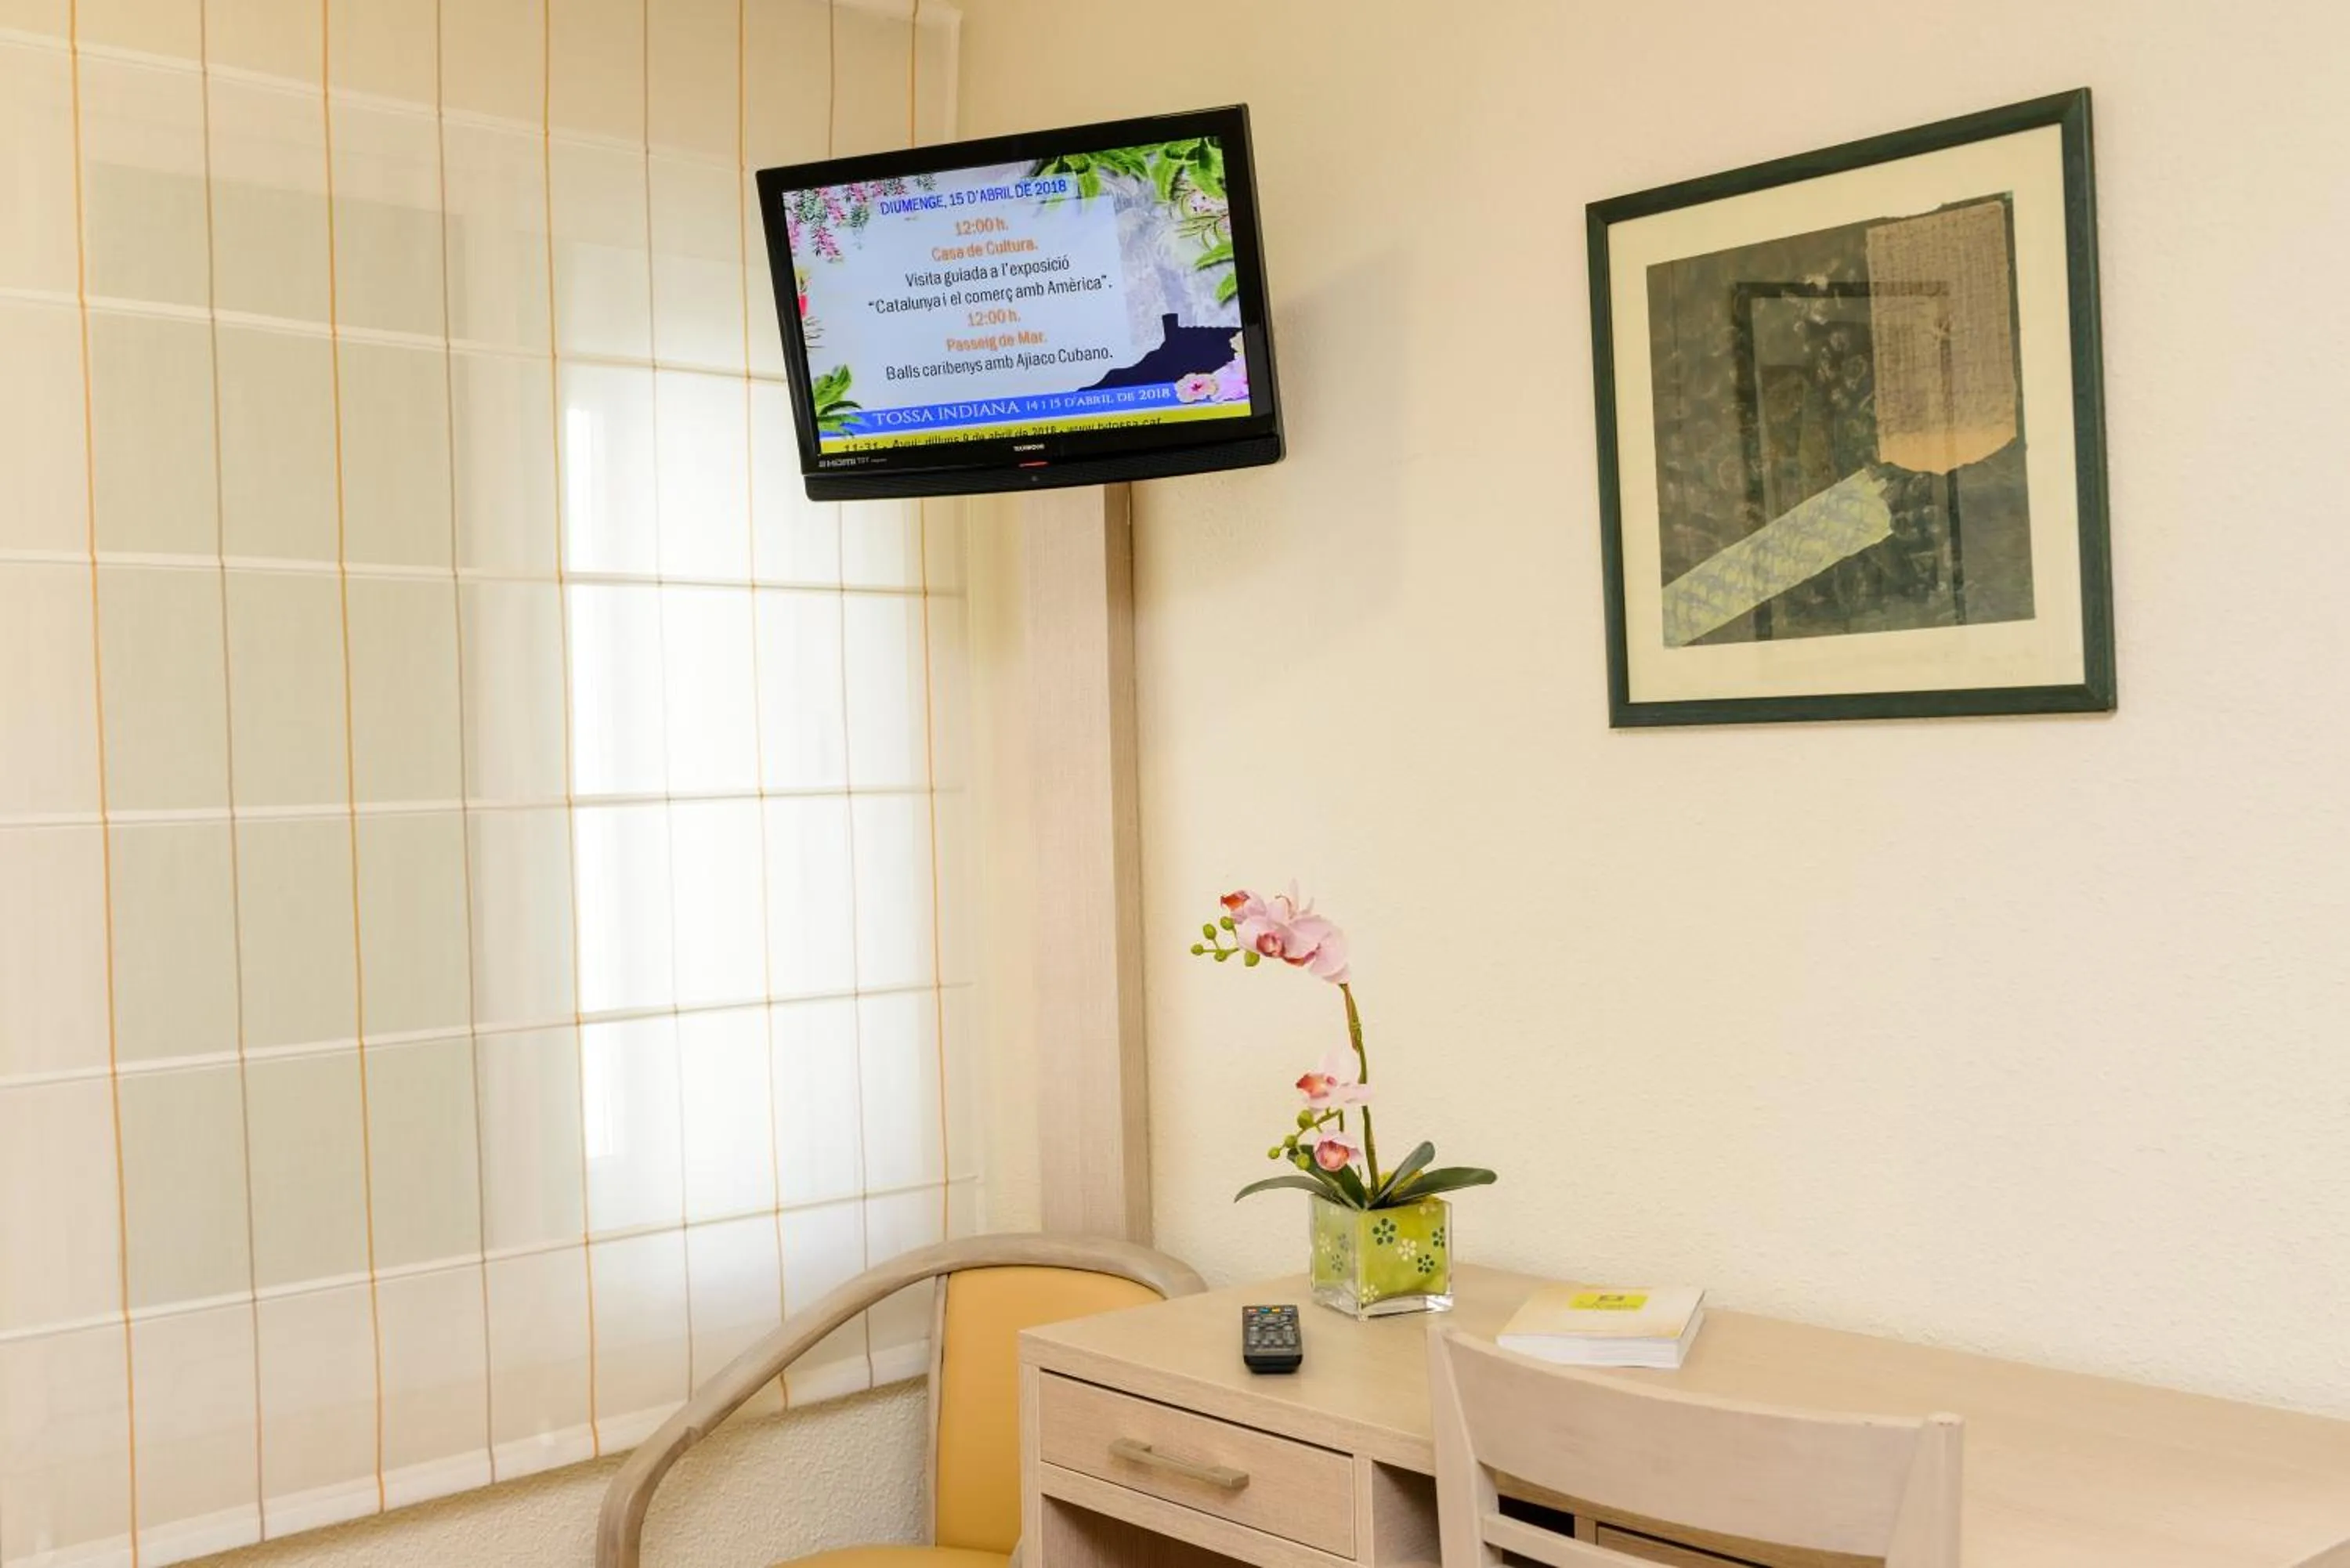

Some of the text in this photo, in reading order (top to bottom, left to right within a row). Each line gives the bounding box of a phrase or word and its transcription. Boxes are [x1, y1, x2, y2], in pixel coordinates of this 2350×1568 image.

[880, 179, 1067, 215] DIUMENGE, 15 D'ABRIL DE 2018
[955, 216, 1009, 236] 12:00 h.
[931, 238, 1039, 262] Casa de Cultura.
[905, 254, 1070, 287] Visita guiada a l'exposició
[942, 292, 947, 306] i
[950, 291, 962, 305] el
[964, 287, 1013, 305] comerç
[1016, 281, 1044, 299] amb
[967, 308, 1021, 327] 12:00 h.
[945, 330, 1047, 352] Passeig de Mar.
[886, 346, 1114, 381] Balls caribenys amb Ajiaco Cubano.
[873, 408, 935, 426] TOSSA
[938, 400, 1020, 421] INDIANA
[1026, 400, 1038, 411] 14
[1050, 399, 1061, 410] 15
[1064, 394, 1114, 408] D'ABRIL
[1117, 392, 1135, 403] DE
[1138, 387, 1171, 400] 2018
